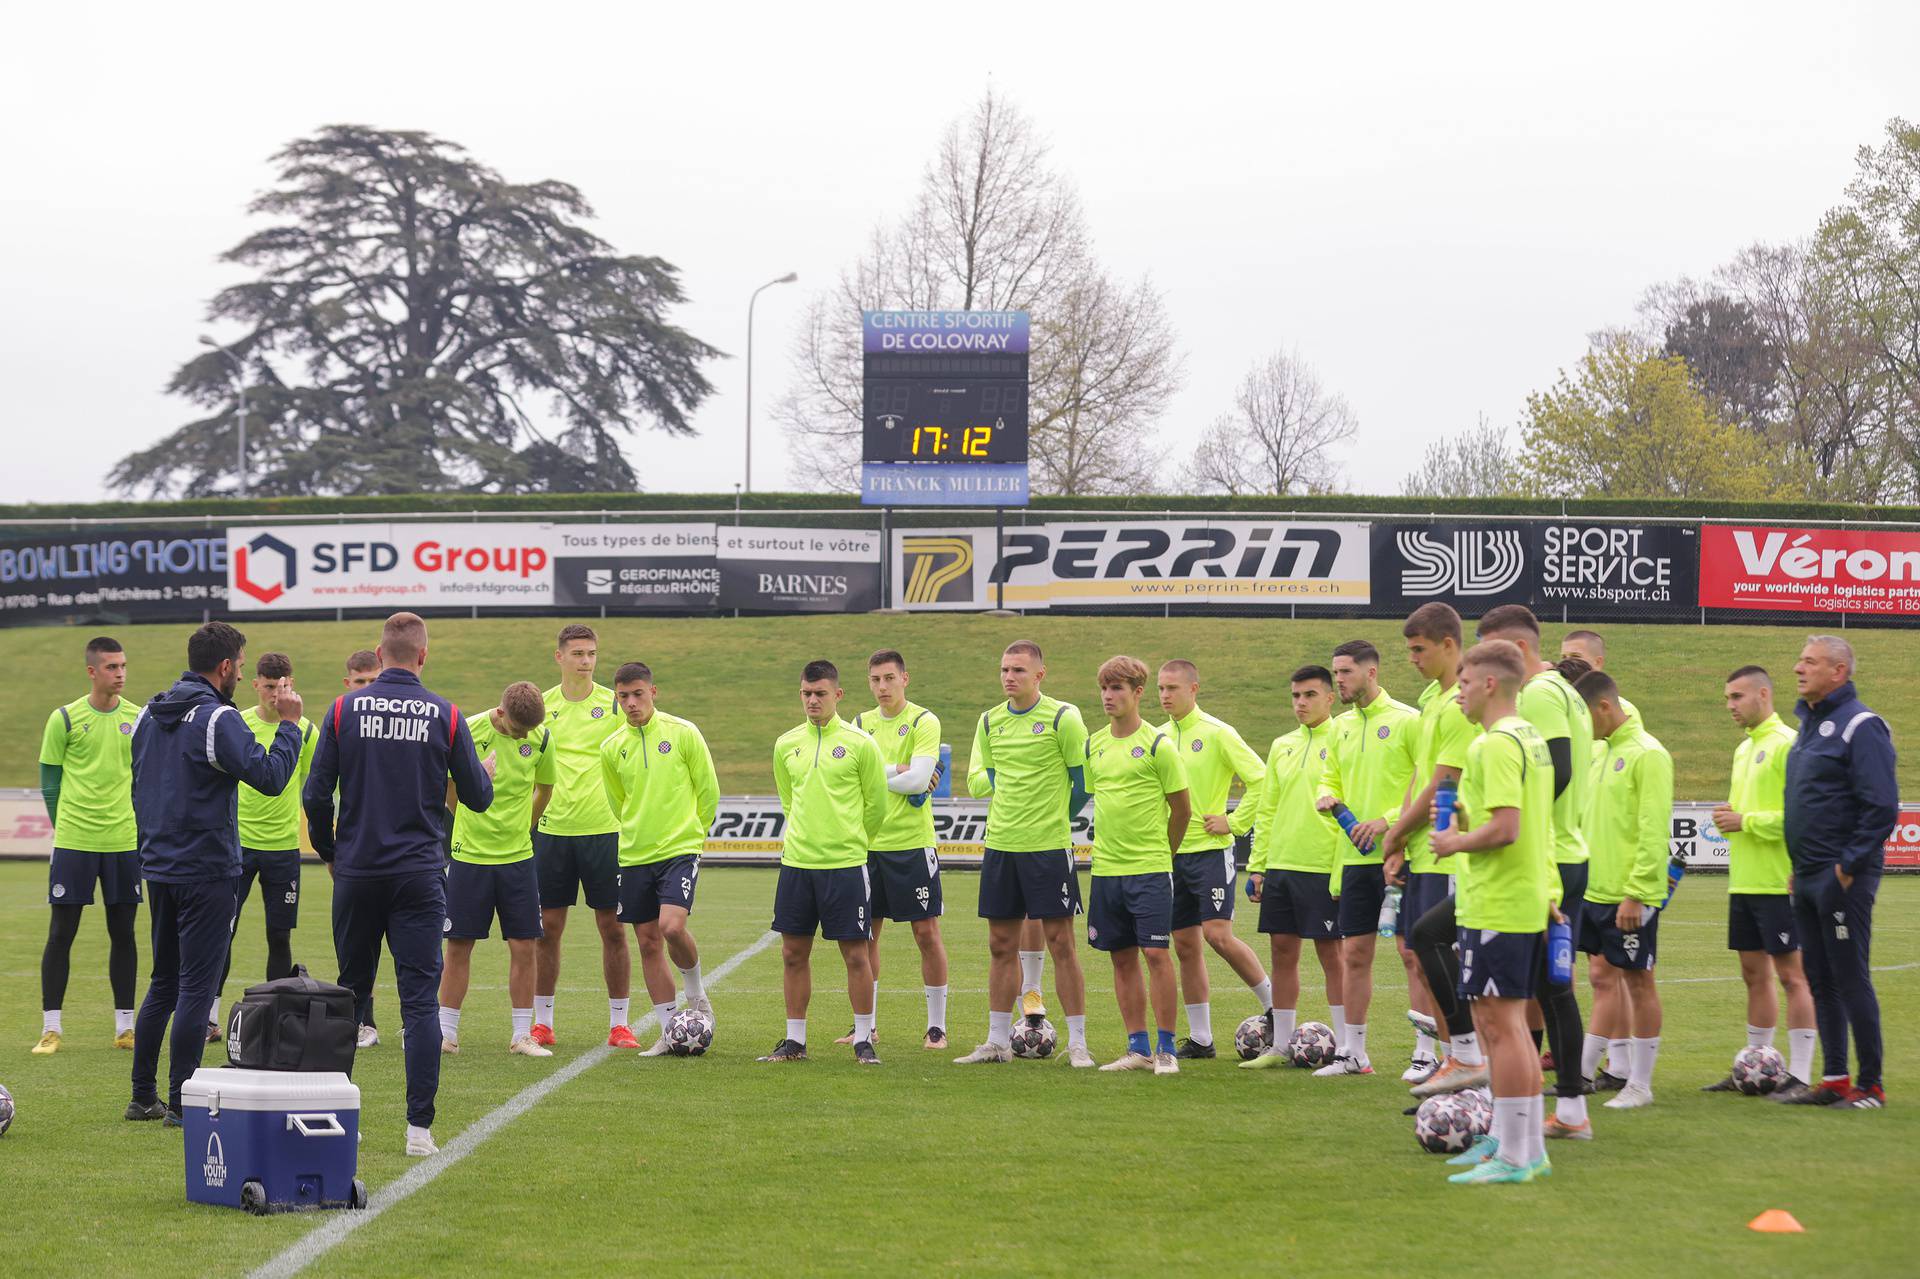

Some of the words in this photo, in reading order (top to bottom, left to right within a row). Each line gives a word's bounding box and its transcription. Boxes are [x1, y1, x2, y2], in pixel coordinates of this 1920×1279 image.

[871, 313, 939, 329] CENTRE
[944, 313, 1016, 329] SPORTIF
[882, 333, 906, 349] DE
[910, 333, 1010, 349] COLOVRAY
[912, 427, 991, 456] 17:12
[870, 476, 942, 492] FRANCK
[950, 476, 1021, 492] MULLER
[562, 535, 598, 547] Tous
[603, 534, 646, 548] types
[651, 534, 671, 546] de
[676, 533, 719, 547] biens
[727, 538, 743, 549] et
[748, 538, 804, 550] surtout
[810, 538, 823, 551] le
[829, 538, 871, 552] vôtre
[1543, 526, 1644, 557] SPORT
[0, 540, 129, 583] BOWLING
[311, 542, 399, 574] SFD
[413, 540, 547, 578] Group
[1732, 530, 1920, 581] Véron
[619, 568, 720, 582] GEROFINANCE
[1543, 555, 1671, 586] SERVICE
[312, 583, 427, 596] www.sfdgroup.ch
[440, 581, 550, 594] info@sfdgroup.ch
[619, 581, 653, 594] RÉGIE
[654, 583, 669, 594] DU
[670, 581, 720, 596] RHÔNE
[758, 573, 848, 596] BARNES
[1131, 582, 1340, 594] www.perrin-freres.ch
[1733, 582, 1761, 594] your
[1765, 582, 1829, 595] worldwide
[1834, 583, 1885, 598] logistics
[1543, 584, 1671, 603] www.sbsport.ch
[1814, 596, 1861, 610] Logistics
[1864, 597, 1893, 610] since
[1897, 598, 1920, 611] 186
[353, 695, 440, 719] macron
[359, 715, 431, 743] HAJDUK
[681, 876, 692, 891] 23
[1061, 882, 1069, 895] 4
[284, 891, 297, 904] 99
[915, 886, 930, 900] 36
[1211, 887, 1226, 901] 30
[858, 906, 864, 919] 8
[1622, 933, 1640, 949] 25
[207, 1155, 218, 1165] UEFA
[203, 1163, 227, 1179] YOUTH
[206, 1177, 224, 1188] LEAGUE
